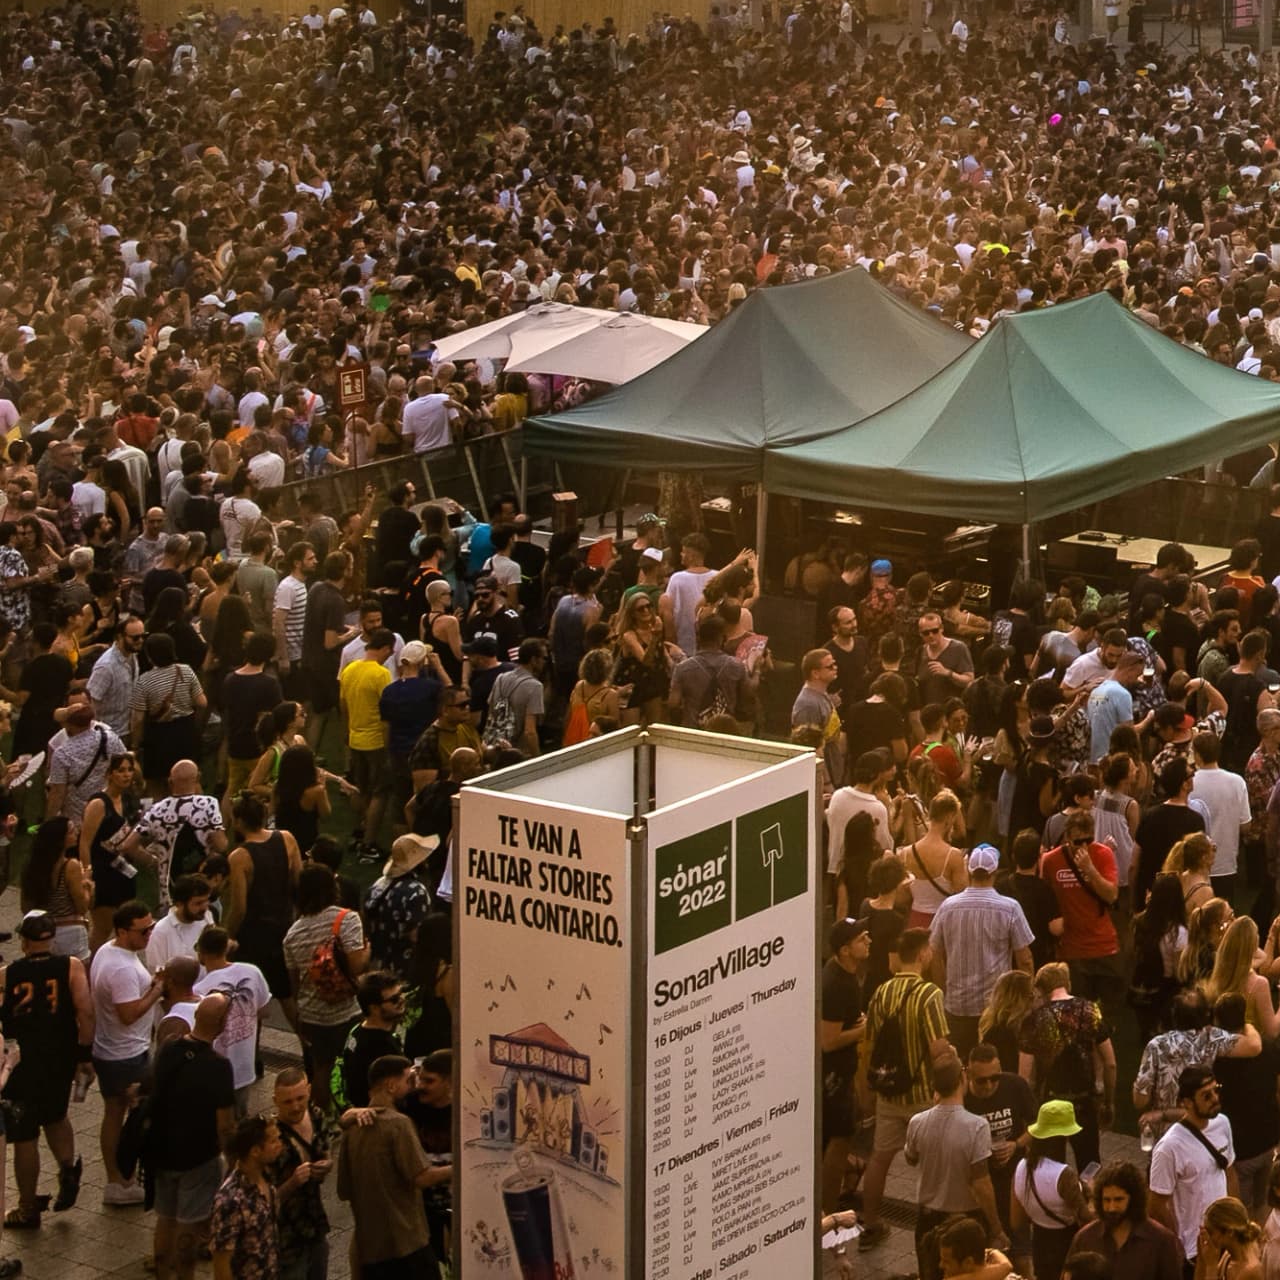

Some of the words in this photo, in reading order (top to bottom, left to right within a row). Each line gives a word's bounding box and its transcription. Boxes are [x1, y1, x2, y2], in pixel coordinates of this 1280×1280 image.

[498, 814, 518, 848] TE
[524, 819, 563, 857] VAN
[568, 828, 582, 860] A
[468, 848, 532, 891] FALTAR
[539, 861, 613, 906] STORIES
[678, 879, 727, 918] 2022
[465, 886, 516, 926] PARA
[520, 897, 623, 948] CONTARLO.
[654, 935, 785, 1007] SonarVillage
[653, 1015, 662, 1026] by
[664, 1004, 688, 1020] Estrella
[690, 995, 712, 1010] Damm
[654, 1034, 667, 1049] 16
[669, 1020, 702, 1041] Dijous
[709, 1001, 744, 1025] Jueves
[751, 977, 796, 1005] Thursday
[654, 1055, 671, 1068] 13:00
[685, 1044, 693, 1055] DJ
[685, 1056, 693, 1067] DJ
[685, 1068, 697, 1079] Live
[713, 1047, 739, 1065] SIMONA
[685, 1080, 693, 1090] DJ
[685, 1104, 693, 1114] DJ
[713, 1086, 729, 1101] LADY
[731, 1076, 753, 1092] SHAKA
[685, 1092, 697, 1103] Live
[685, 1116, 697, 1126] Live
[713, 1095, 737, 1113] PONGO
[685, 1128, 693, 1138] DJ
[712, 1109, 732, 1125] JAYDA
[734, 1105, 739, 1113] G
[654, 1163, 666, 1176] 17
[668, 1139, 720, 1171] Divendres
[726, 1116, 763, 1141] Viernes
[769, 1098, 799, 1120] Friday
[684, 1171, 693, 1182] DJ
[684, 1180, 698, 1194] LIVE
[684, 1195, 693, 1206] DJ
[684, 1207, 696, 1218] Live
[684, 1231, 696, 1242] Live
[737, 1200, 751, 1214] PAN
[684, 1219, 693, 1230] DJ
[684, 1243, 693, 1253] DJ
[719, 1243, 757, 1271] Sábado
[763, 1217, 807, 1247] Saturday
[684, 1255, 693, 1266] DJ
